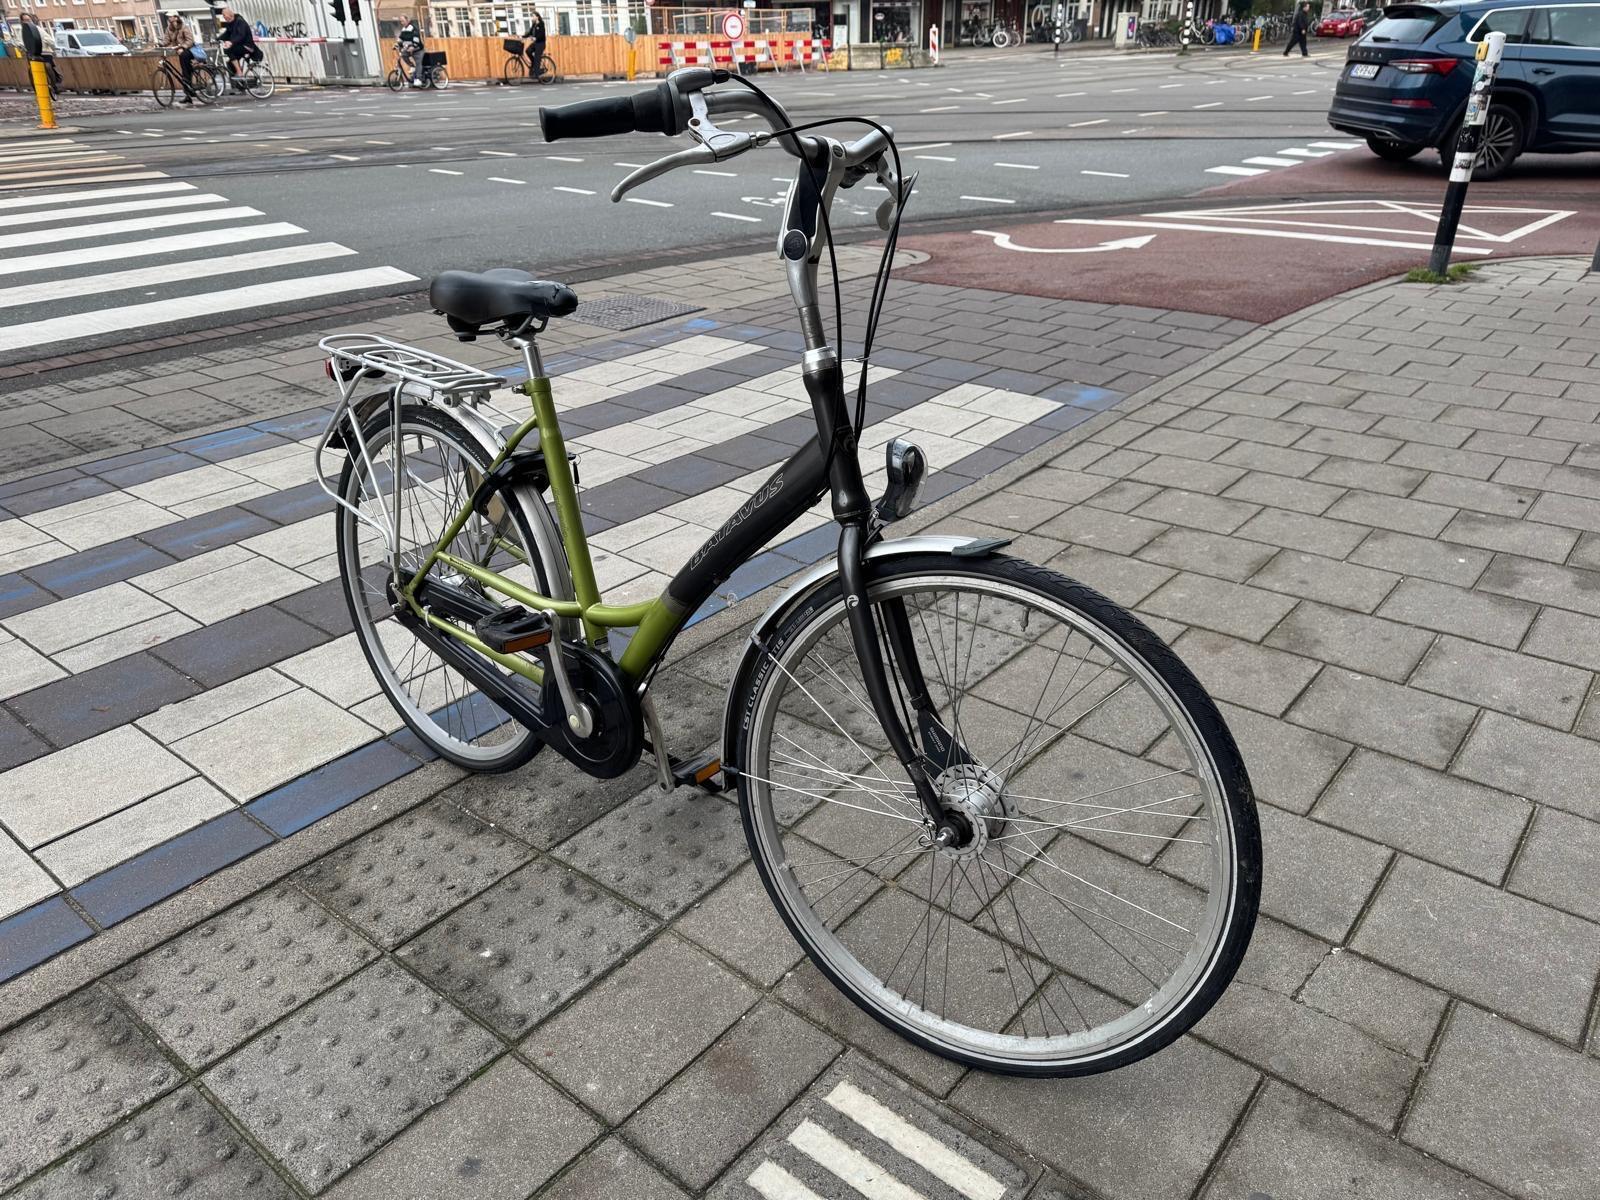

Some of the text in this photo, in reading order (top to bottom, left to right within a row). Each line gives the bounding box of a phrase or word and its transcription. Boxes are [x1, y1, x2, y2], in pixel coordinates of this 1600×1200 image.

[690, 472, 785, 571] BATAVUS
[743, 710, 751, 730] CST
[748, 661, 771, 707] CLASSIC
